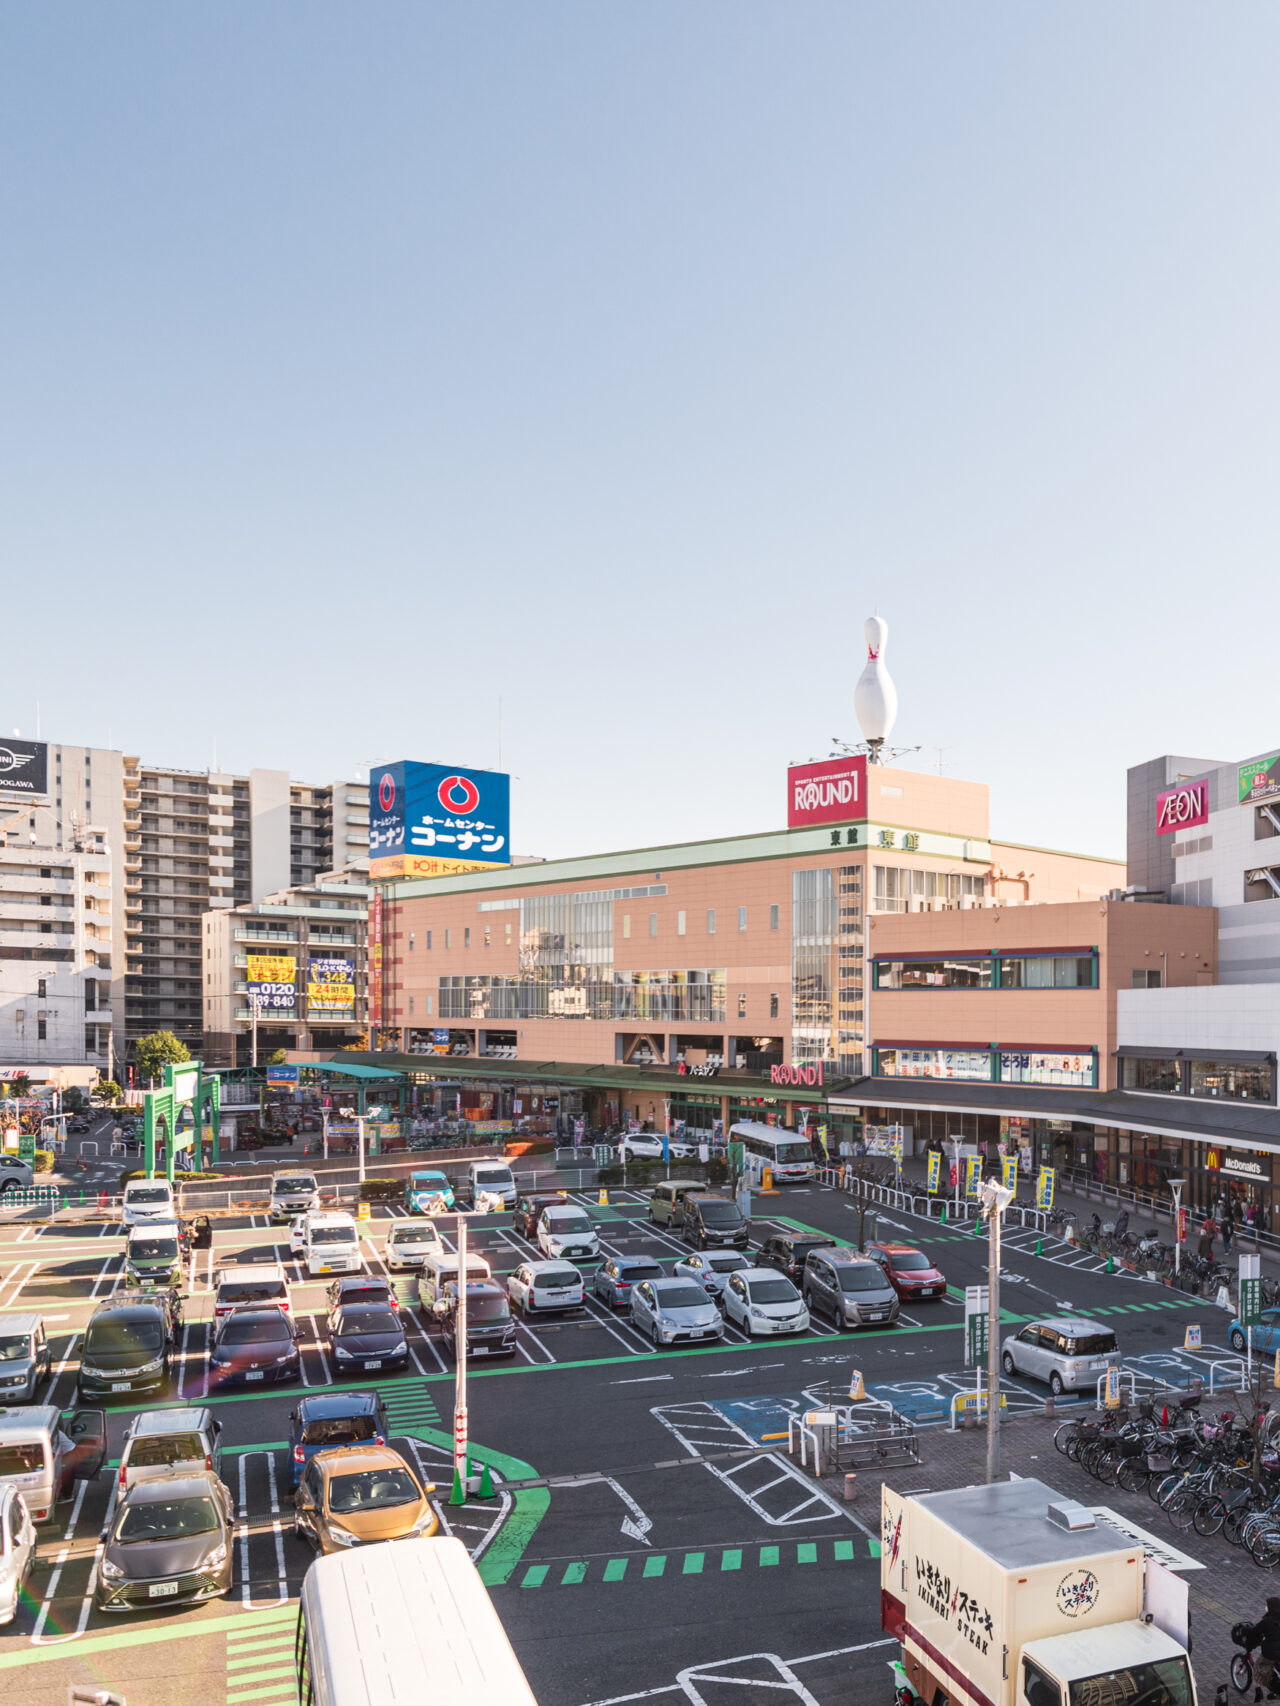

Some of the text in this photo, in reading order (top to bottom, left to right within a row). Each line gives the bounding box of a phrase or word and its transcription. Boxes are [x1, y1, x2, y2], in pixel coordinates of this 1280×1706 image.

[0, 756, 12, 764] INI
[422, 815, 495, 830] ホームセンター
[370, 826, 405, 849] コーナン
[411, 826, 505, 852] コーナン
[261, 984, 294, 995] 0120
[1225, 1158, 1262, 1174] McDonald's
[916, 1555, 951, 1604] いきなり
[1062, 1581, 1094, 1597] いきなり
[918, 1584, 989, 1655] IKINARI STEAK
